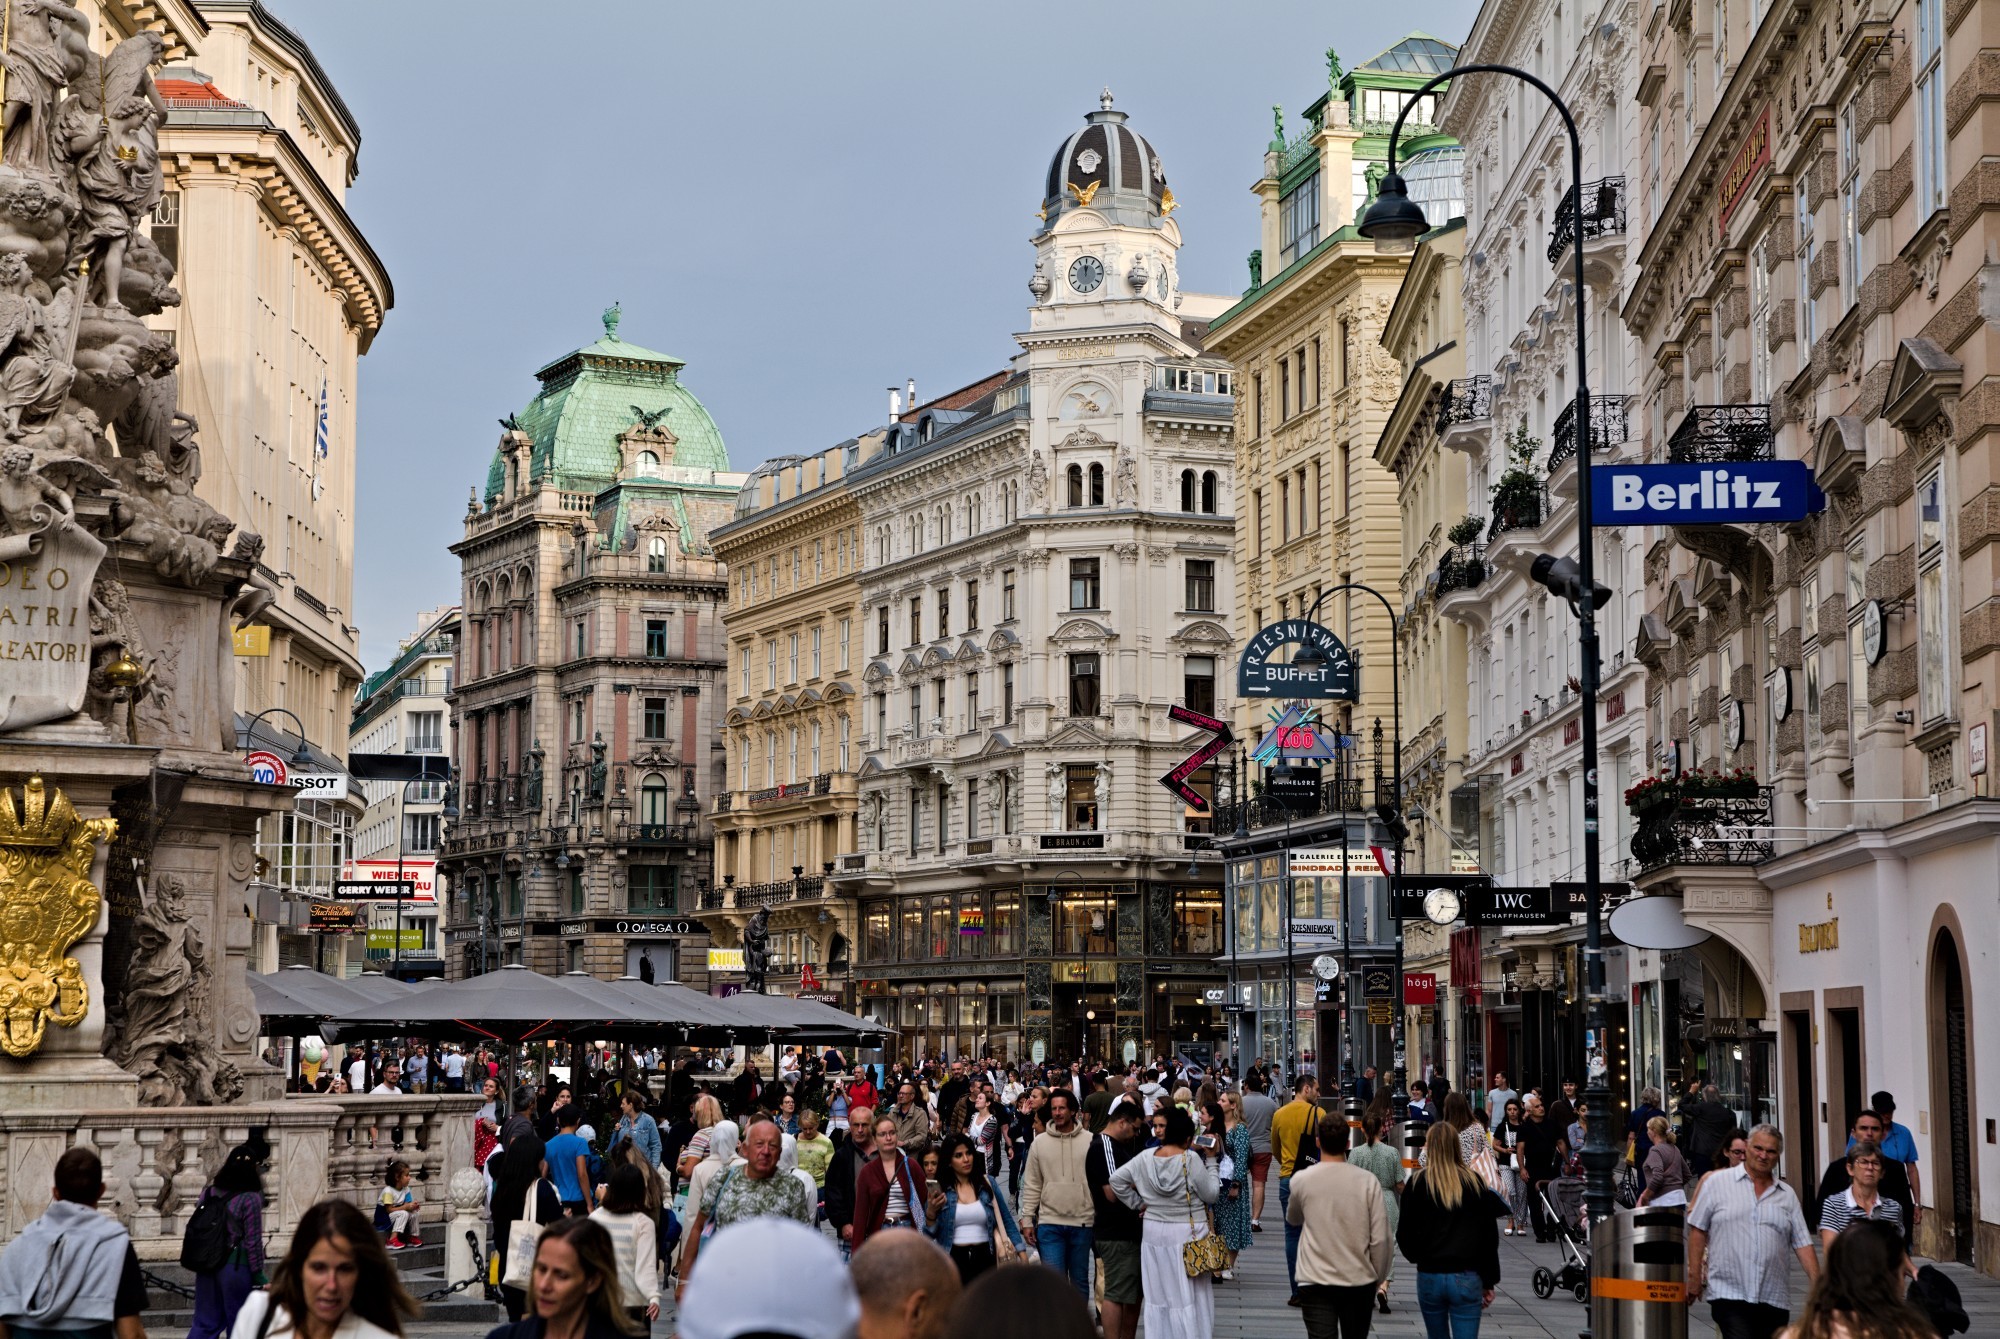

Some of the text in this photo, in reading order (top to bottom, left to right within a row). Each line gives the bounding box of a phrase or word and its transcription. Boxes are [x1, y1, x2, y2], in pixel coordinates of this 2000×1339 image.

[1612, 469, 1781, 511] Berlitz
[0, 605, 78, 627] ATRI
[1246, 623, 1350, 677] TRZEŚNIEWSKI
[1266, 667, 1329, 682] BUFFET
[1173, 707, 1223, 729] DISCOTHEQUE
[1277, 726, 1314, 749] KÖÖ
[248, 755, 284, 777] cherungsdienst
[1172, 741, 1226, 782] FLEDERMAUS
[254, 769, 275, 783] WD
[290, 778, 338, 789] ISSOT
[1181, 786, 1195, 799] BAR
[1056, 837, 1080, 846] BRAUN
[338, 885, 372, 894] GERRY
[1494, 893, 1532, 909] IWC
[1568, 893, 1612, 902] BAY
[963, 915, 981, 928] H&M
[1291, 923, 1334, 933] RZEŚNIEWSKI
[505, 927, 519, 937] OMEGA
[566, 924, 581, 934] OMEGA
[1407, 977, 1433, 989] högl
